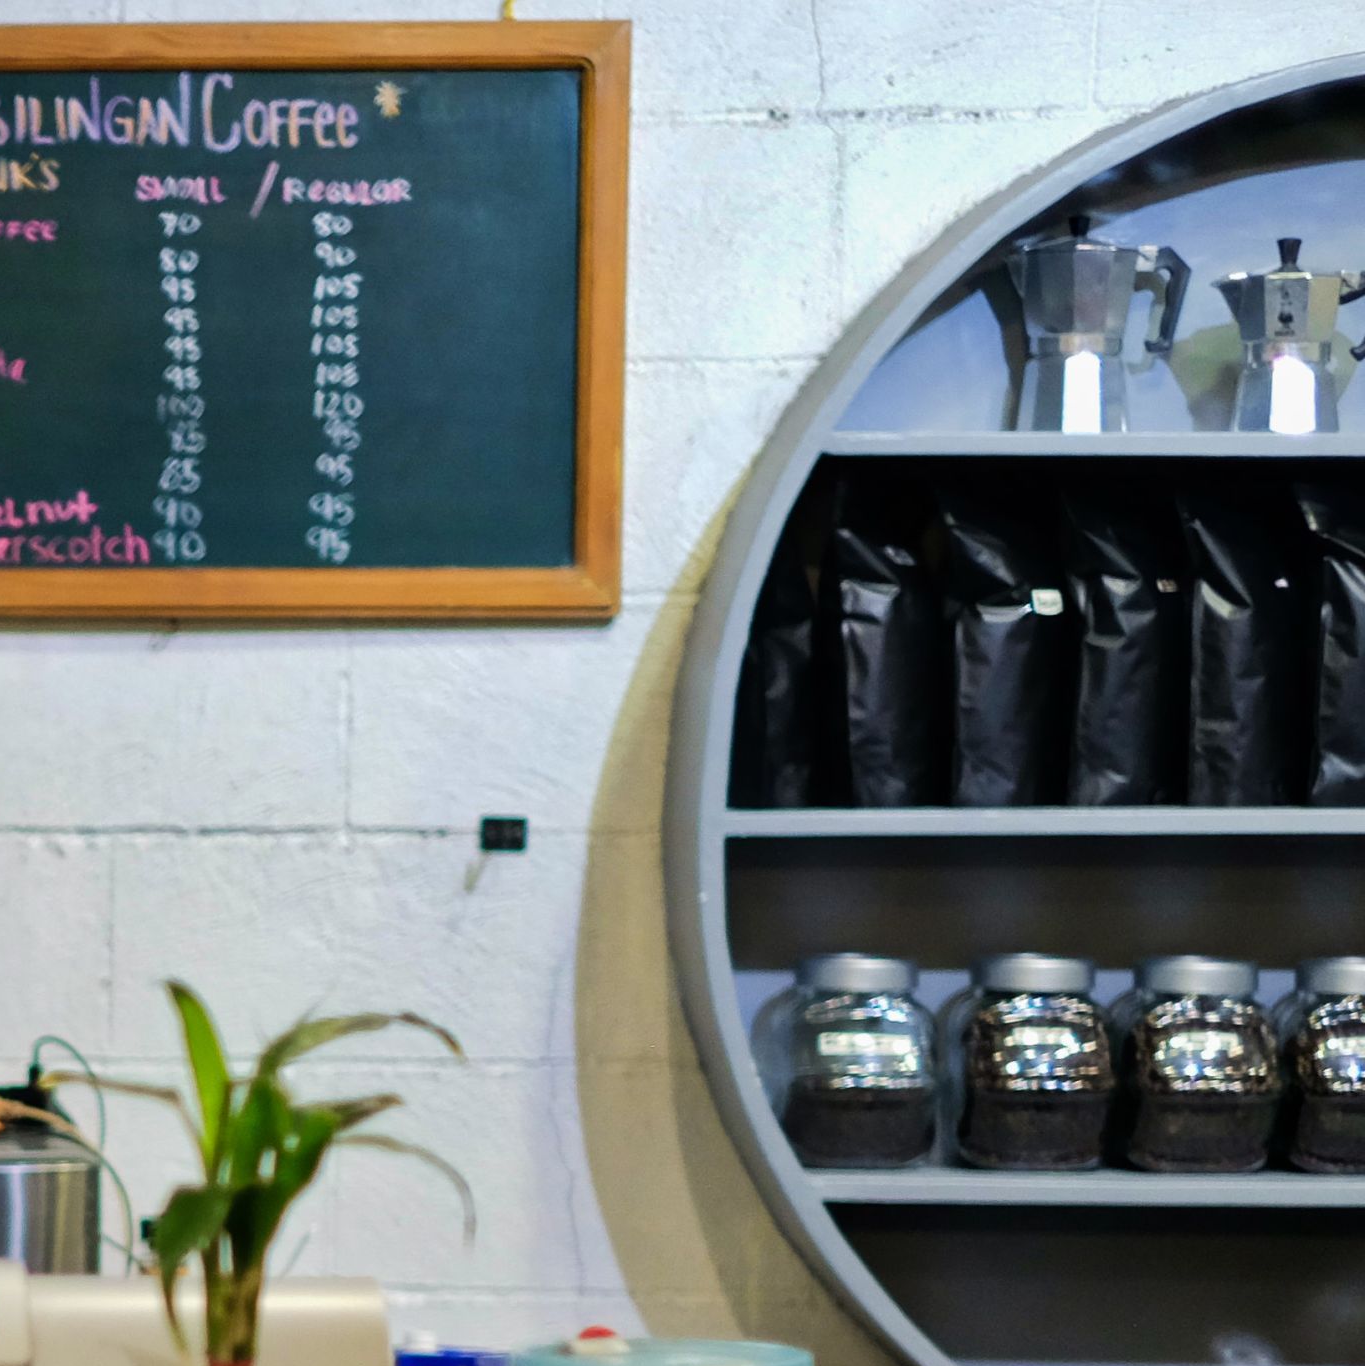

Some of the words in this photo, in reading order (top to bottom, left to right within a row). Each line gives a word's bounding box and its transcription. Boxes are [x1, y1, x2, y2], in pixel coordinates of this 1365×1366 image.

[159, 211, 202, 238] 70
[312, 210, 353, 237] 80
[159, 247, 200, 273] 80
[314, 241, 357, 268] 90
[161, 275, 197, 303] 95
[313, 273, 364, 301] 105
[163, 306, 200, 332] 95
[310, 304, 360, 330] 105
[164, 335, 203, 362] 95
[310, 332, 360, 359] 105
[162, 364, 203, 391] 95
[314, 361, 360, 388] 105
[312, 389, 365, 420] 120
